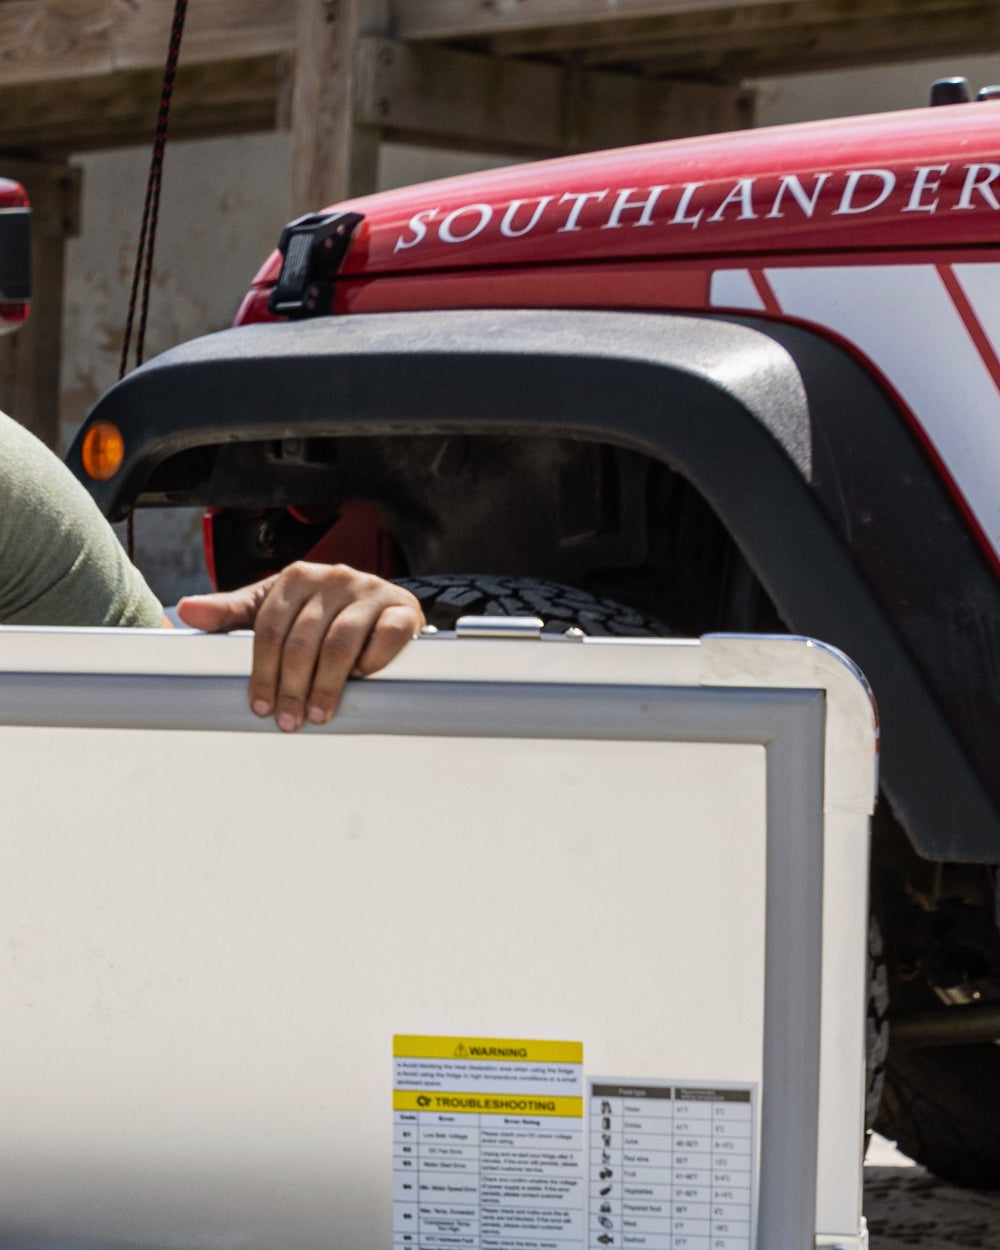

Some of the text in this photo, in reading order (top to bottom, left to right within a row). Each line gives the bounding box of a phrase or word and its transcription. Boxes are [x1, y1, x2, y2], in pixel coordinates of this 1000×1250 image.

[393, 162, 1000, 252] SOUTHLANDER
[469, 1045, 527, 1058] WARNING
[435, 1096, 556, 1111] TROUBLESHOOTING
